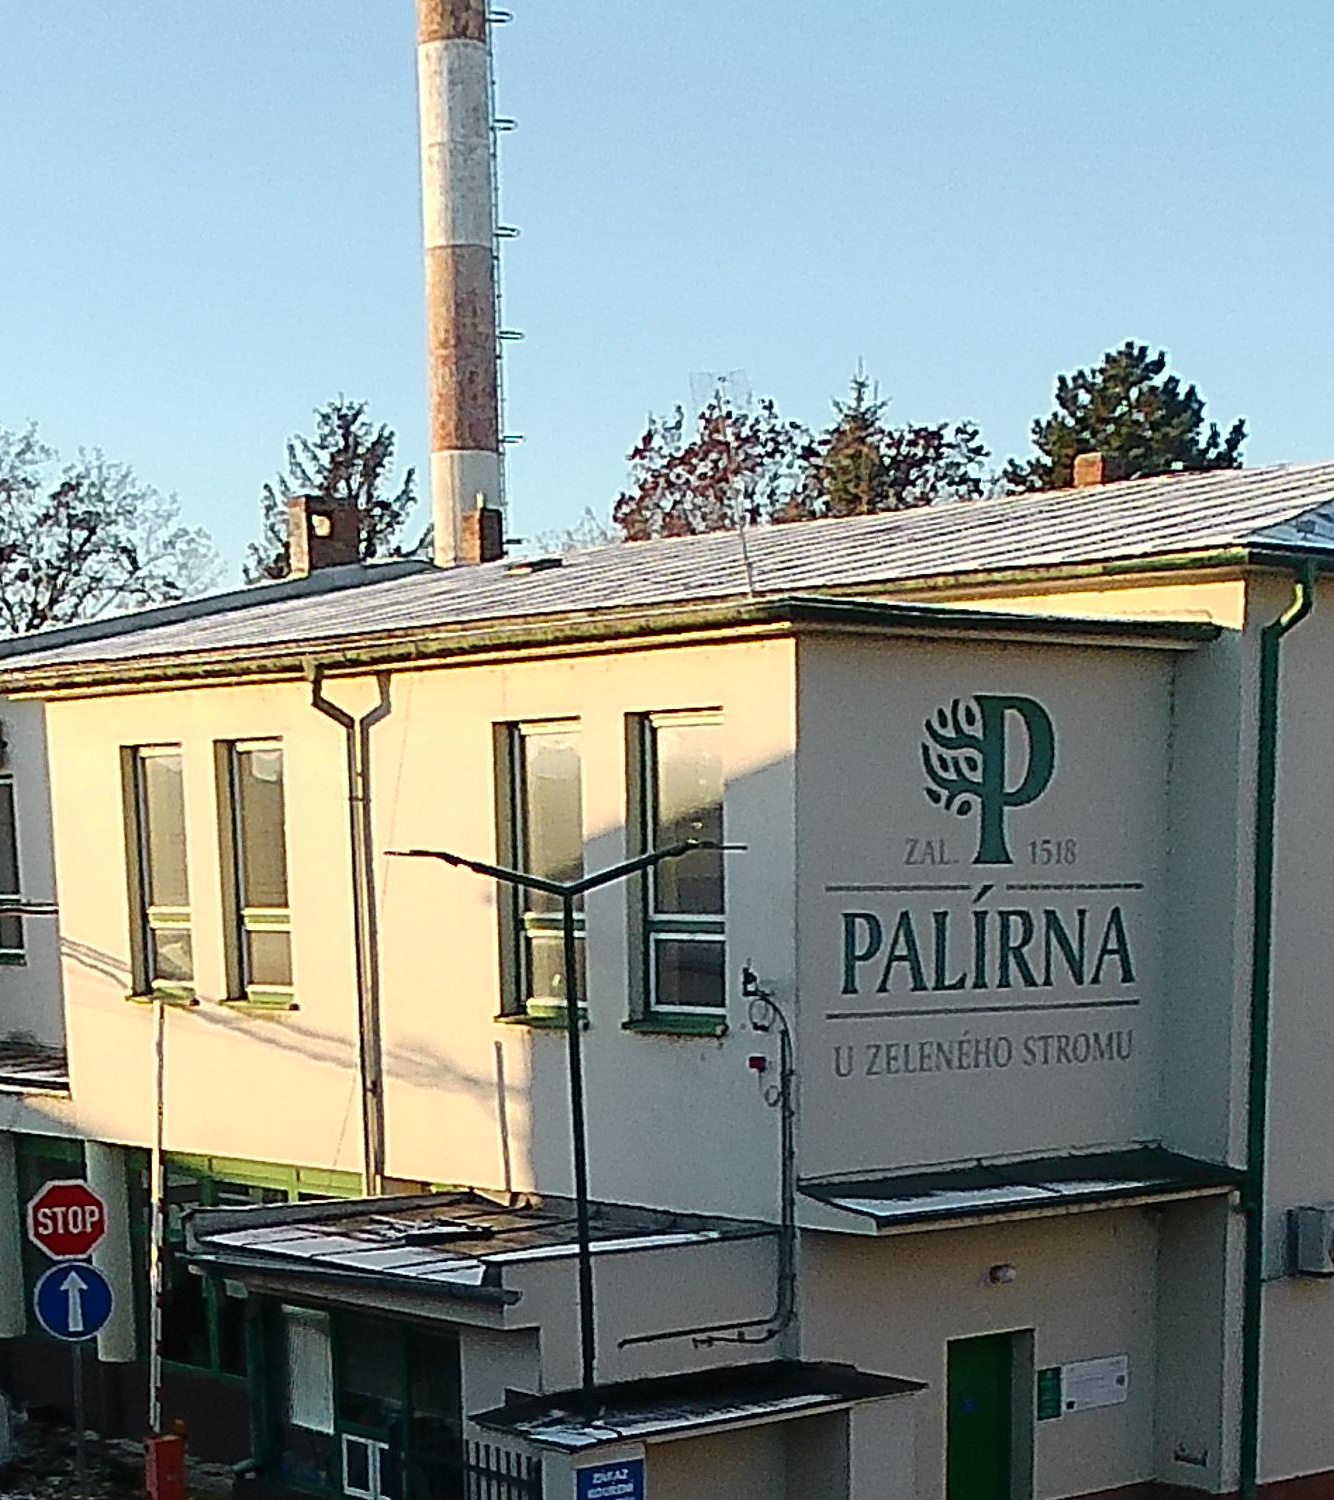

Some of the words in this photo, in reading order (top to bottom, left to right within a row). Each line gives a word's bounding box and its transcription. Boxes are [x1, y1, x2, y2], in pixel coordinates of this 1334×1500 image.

[904, 837, 960, 865] ZAL.
[1027, 839, 1077, 866] 1518
[841, 884, 1135, 994] PALÍRNA
[834, 1045, 854, 1078] U
[865, 1030, 1013, 1076] ZELENÉHO
[1023, 1030, 1134, 1067] STROMU
[38, 1205, 100, 1235] STOP
